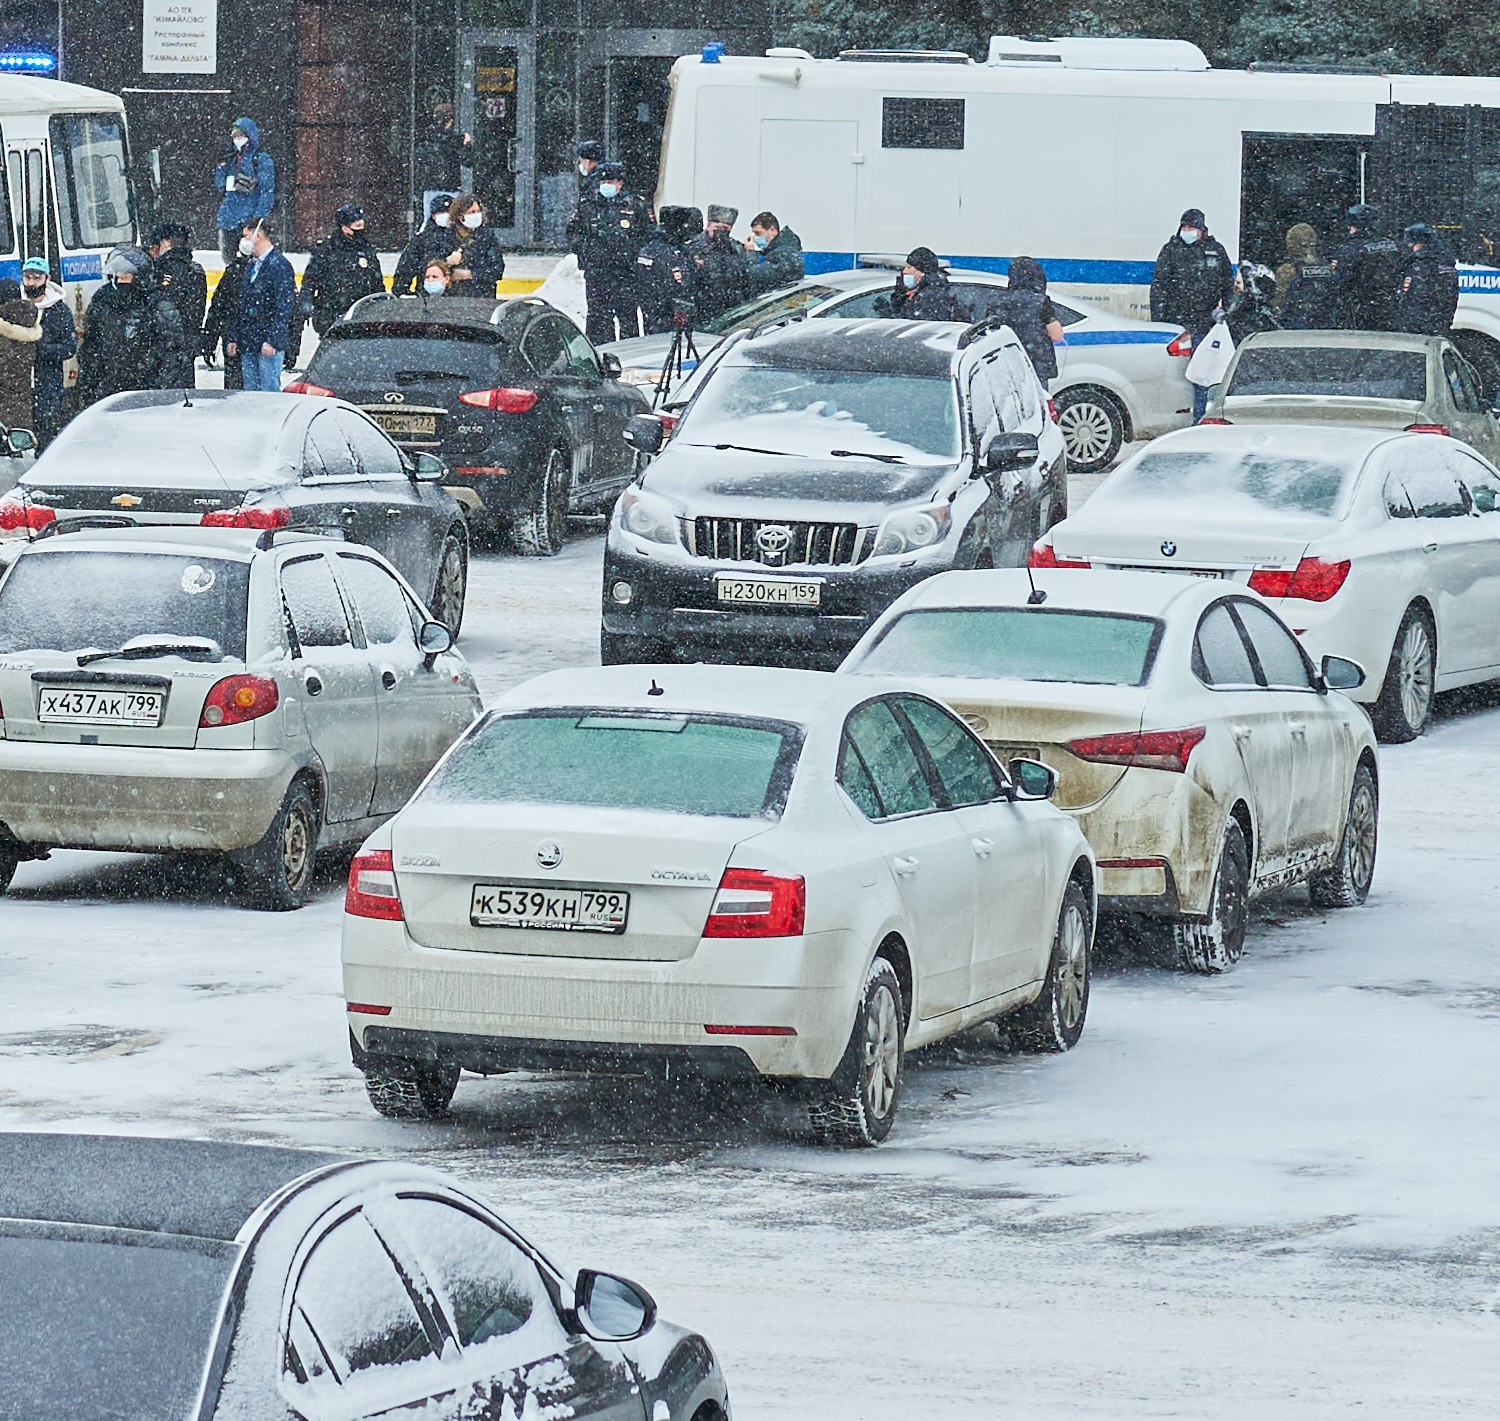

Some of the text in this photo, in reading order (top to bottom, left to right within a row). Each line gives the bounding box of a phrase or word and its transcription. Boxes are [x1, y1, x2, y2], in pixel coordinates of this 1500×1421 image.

[723, 583, 817, 601] Н230КН 159
[45, 693, 156, 716] Х437АК 799
[650, 869, 712, 882] OCTAVIA
[481, 891, 621, 919] К539КН 799
